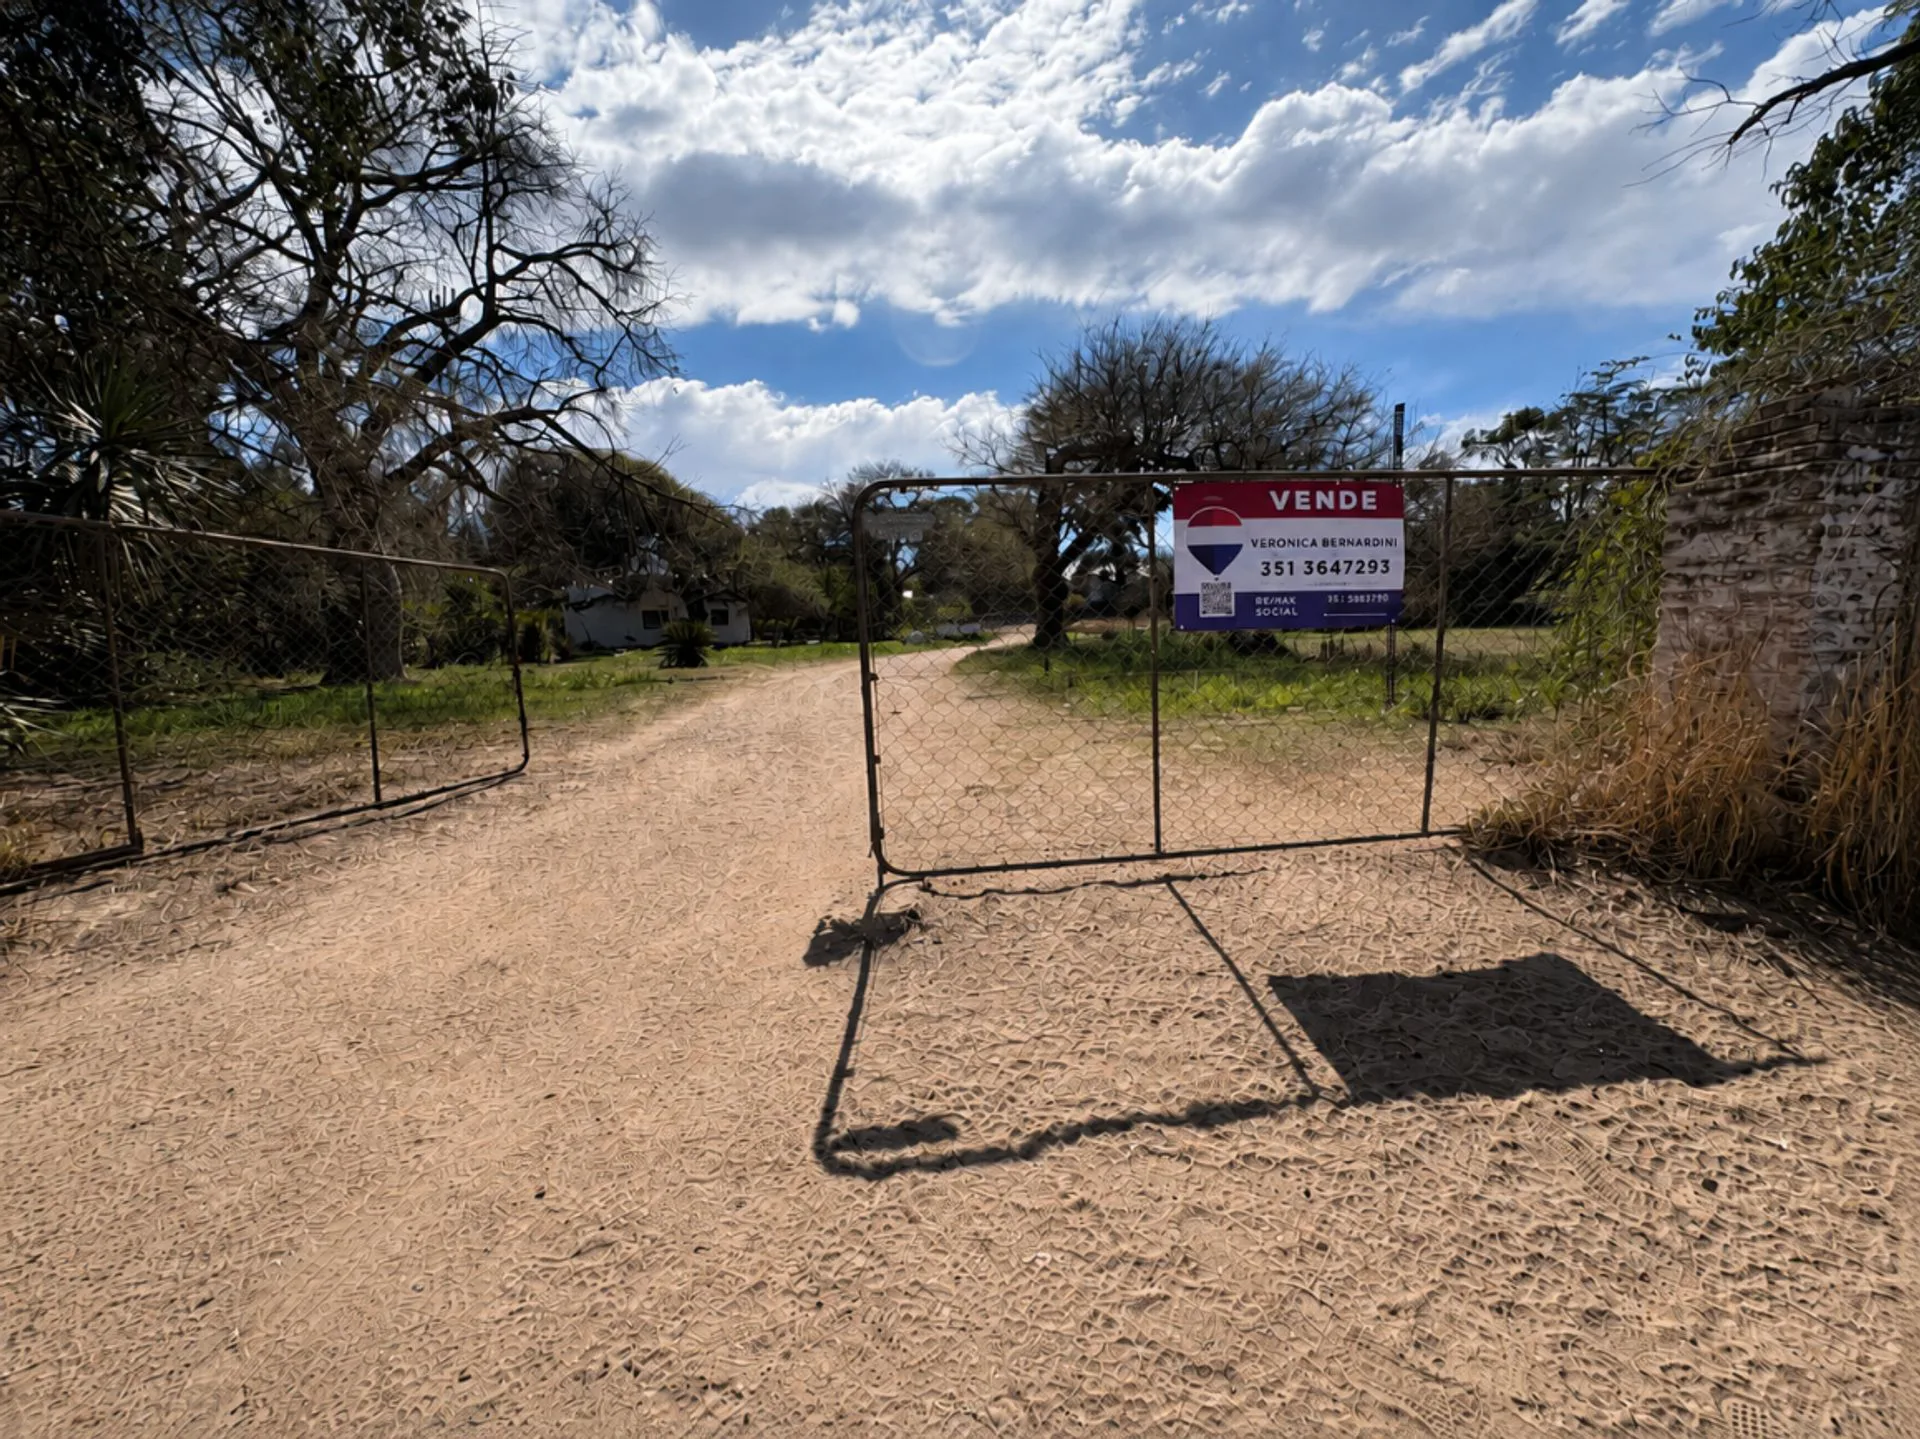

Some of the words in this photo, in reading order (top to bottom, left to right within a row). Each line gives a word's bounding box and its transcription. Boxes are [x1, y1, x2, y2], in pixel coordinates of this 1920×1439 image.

[1269, 490, 1378, 511] VENDE
[1251, 538, 1317, 549] VERONICA
[1321, 537, 1398, 549] BERNARDINI
[1260, 560, 1295, 577] 351
[1303, 559, 1391, 576] 3647293
[1255, 595, 1296, 606] RE/MAX
[1255, 607, 1298, 617] SOCIAL
